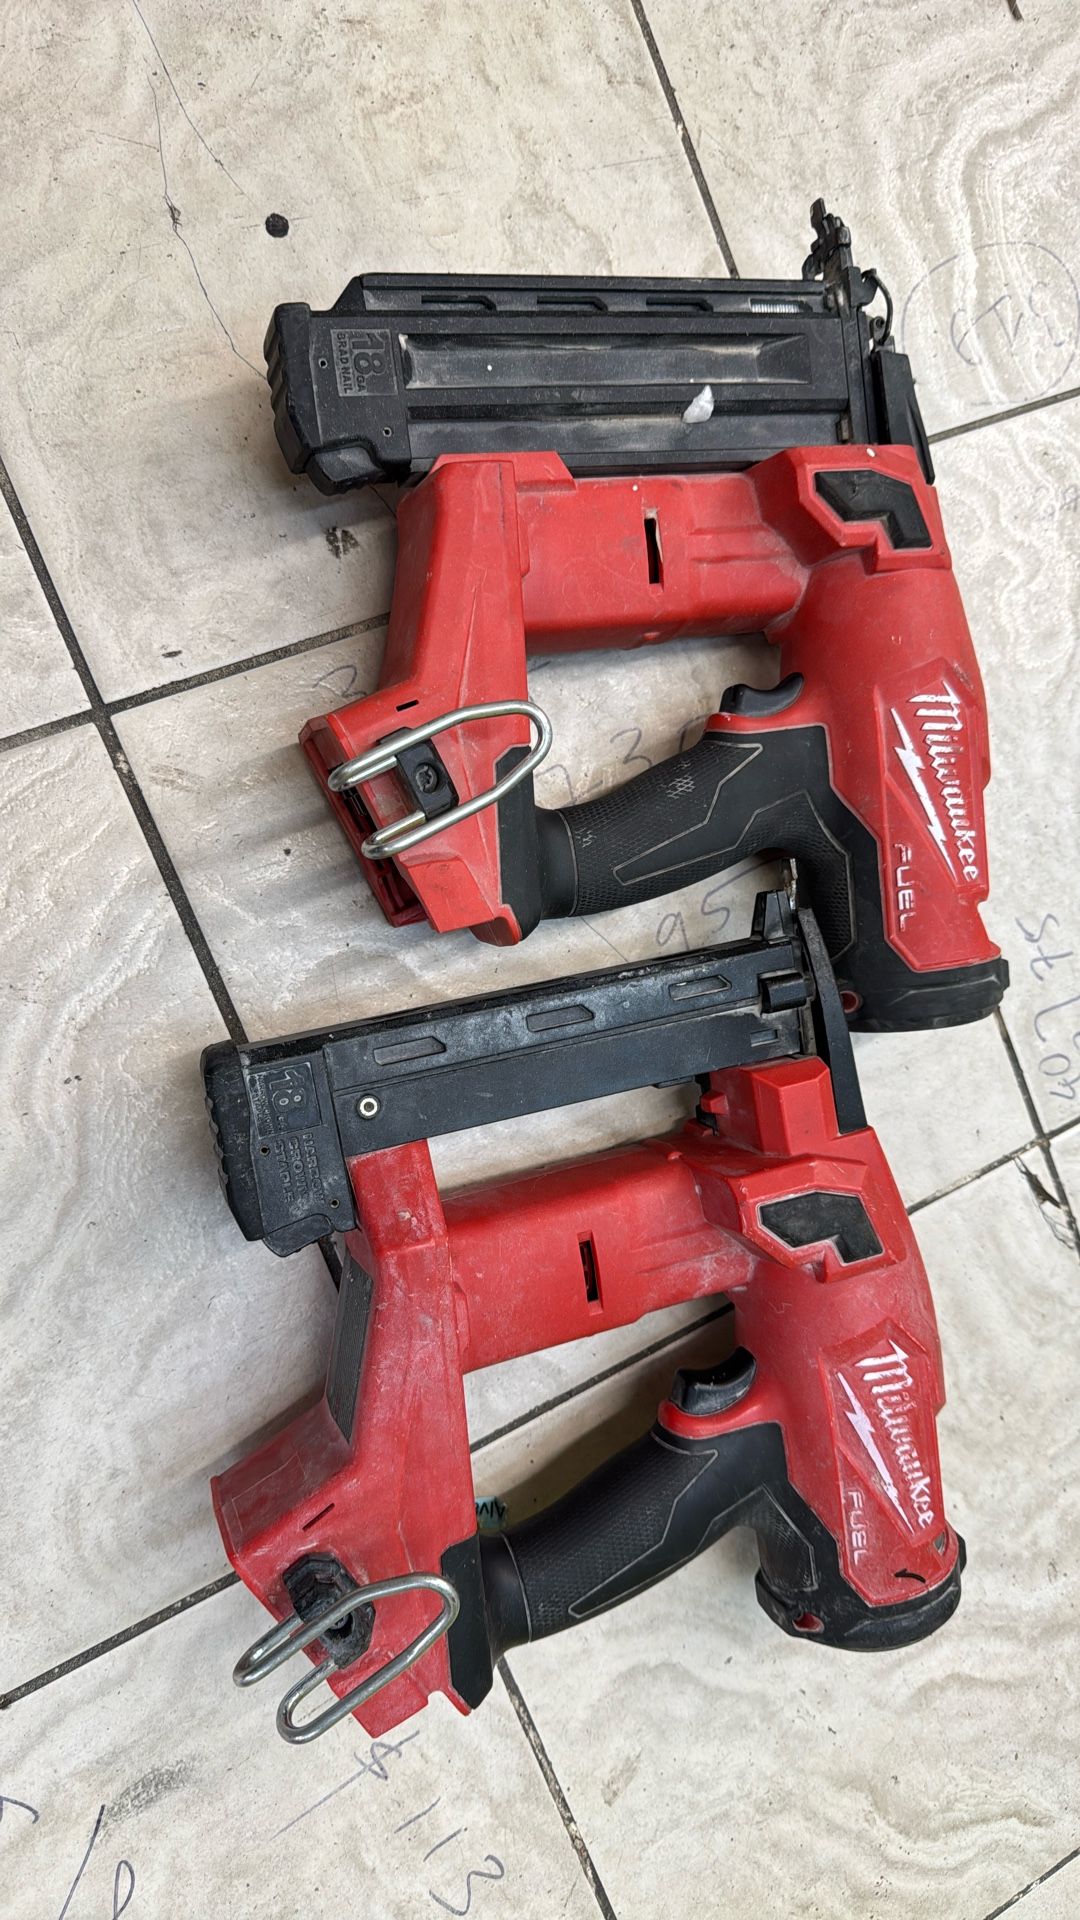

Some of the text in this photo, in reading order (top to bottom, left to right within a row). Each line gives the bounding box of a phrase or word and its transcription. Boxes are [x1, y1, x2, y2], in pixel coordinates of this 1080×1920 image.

[336, 332, 353, 395] BRAD NAIL
[351, 331, 386, 393] 18 GA
[907, 680, 979, 882] Milwaukee
[894, 843, 916, 932] FUEL
[269, 1069, 307, 1113] 18
[273, 1138, 295, 1203] STAPLE
[288, 1135, 310, 1196] CROWN
[302, 1131, 325, 1204] NARROW
[854, 1339, 934, 1529] Milwaukee
[847, 1490, 867, 1566] FUEL
